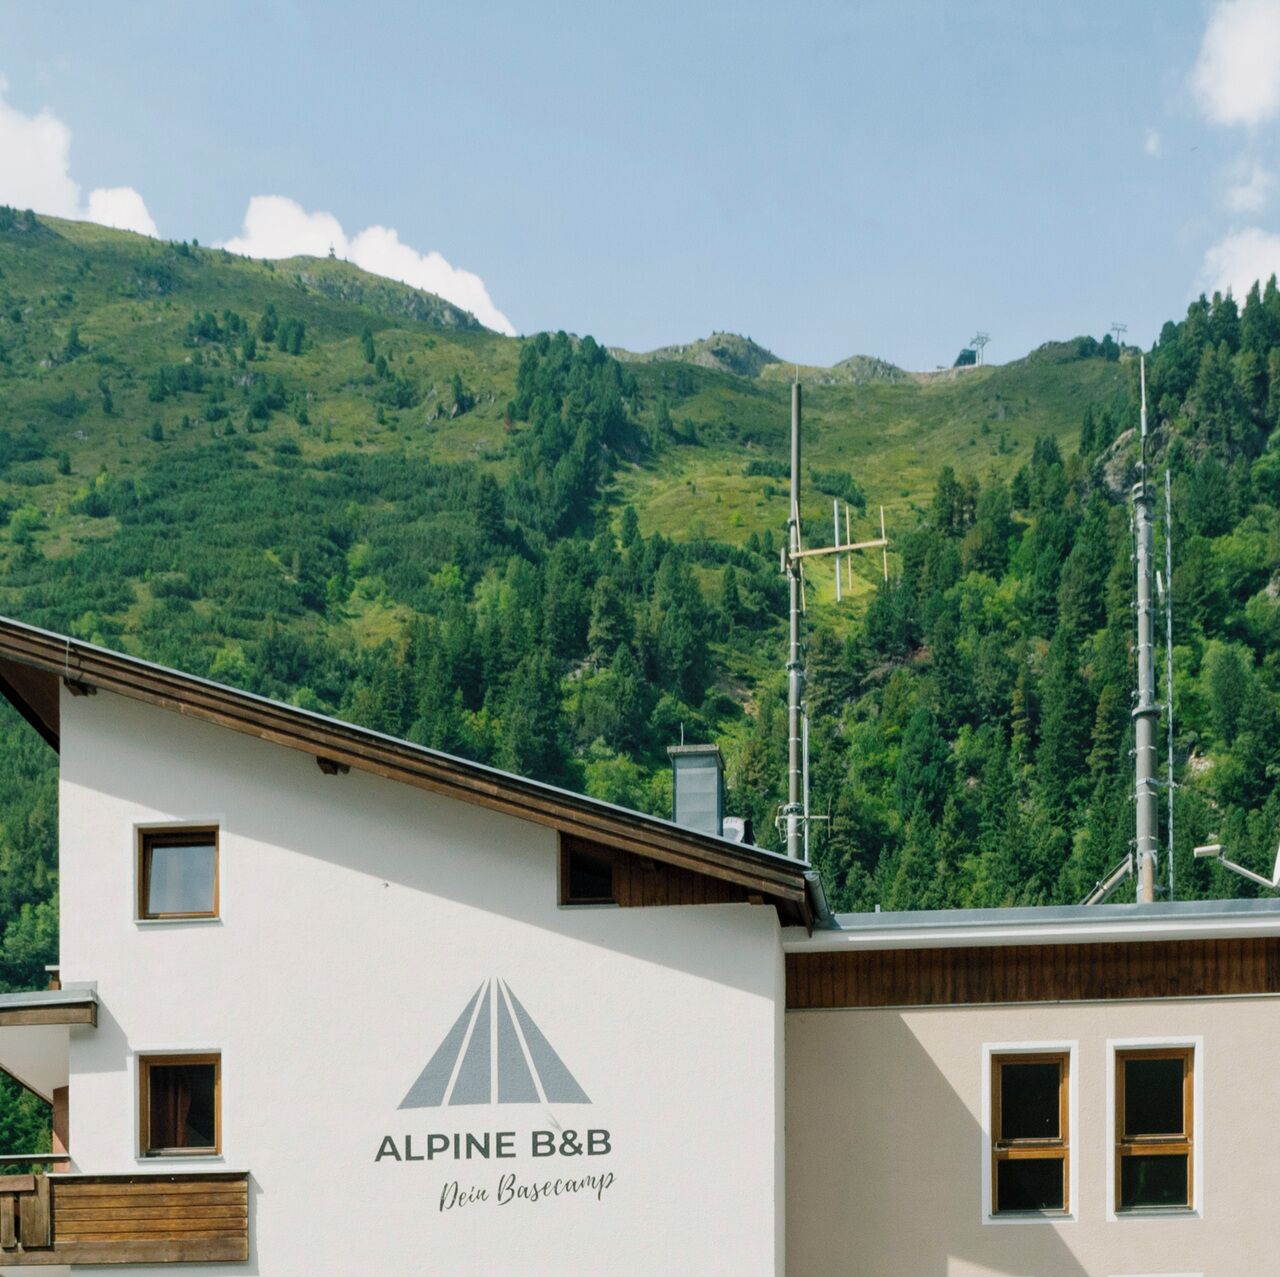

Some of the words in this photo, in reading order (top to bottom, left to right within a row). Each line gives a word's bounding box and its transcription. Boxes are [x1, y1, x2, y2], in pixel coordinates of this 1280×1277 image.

[374, 1131, 517, 1163] ALPINE
[531, 1129, 613, 1158] B&B
[439, 1181, 489, 1213] Dein
[496, 1172, 617, 1207] Basecamp
